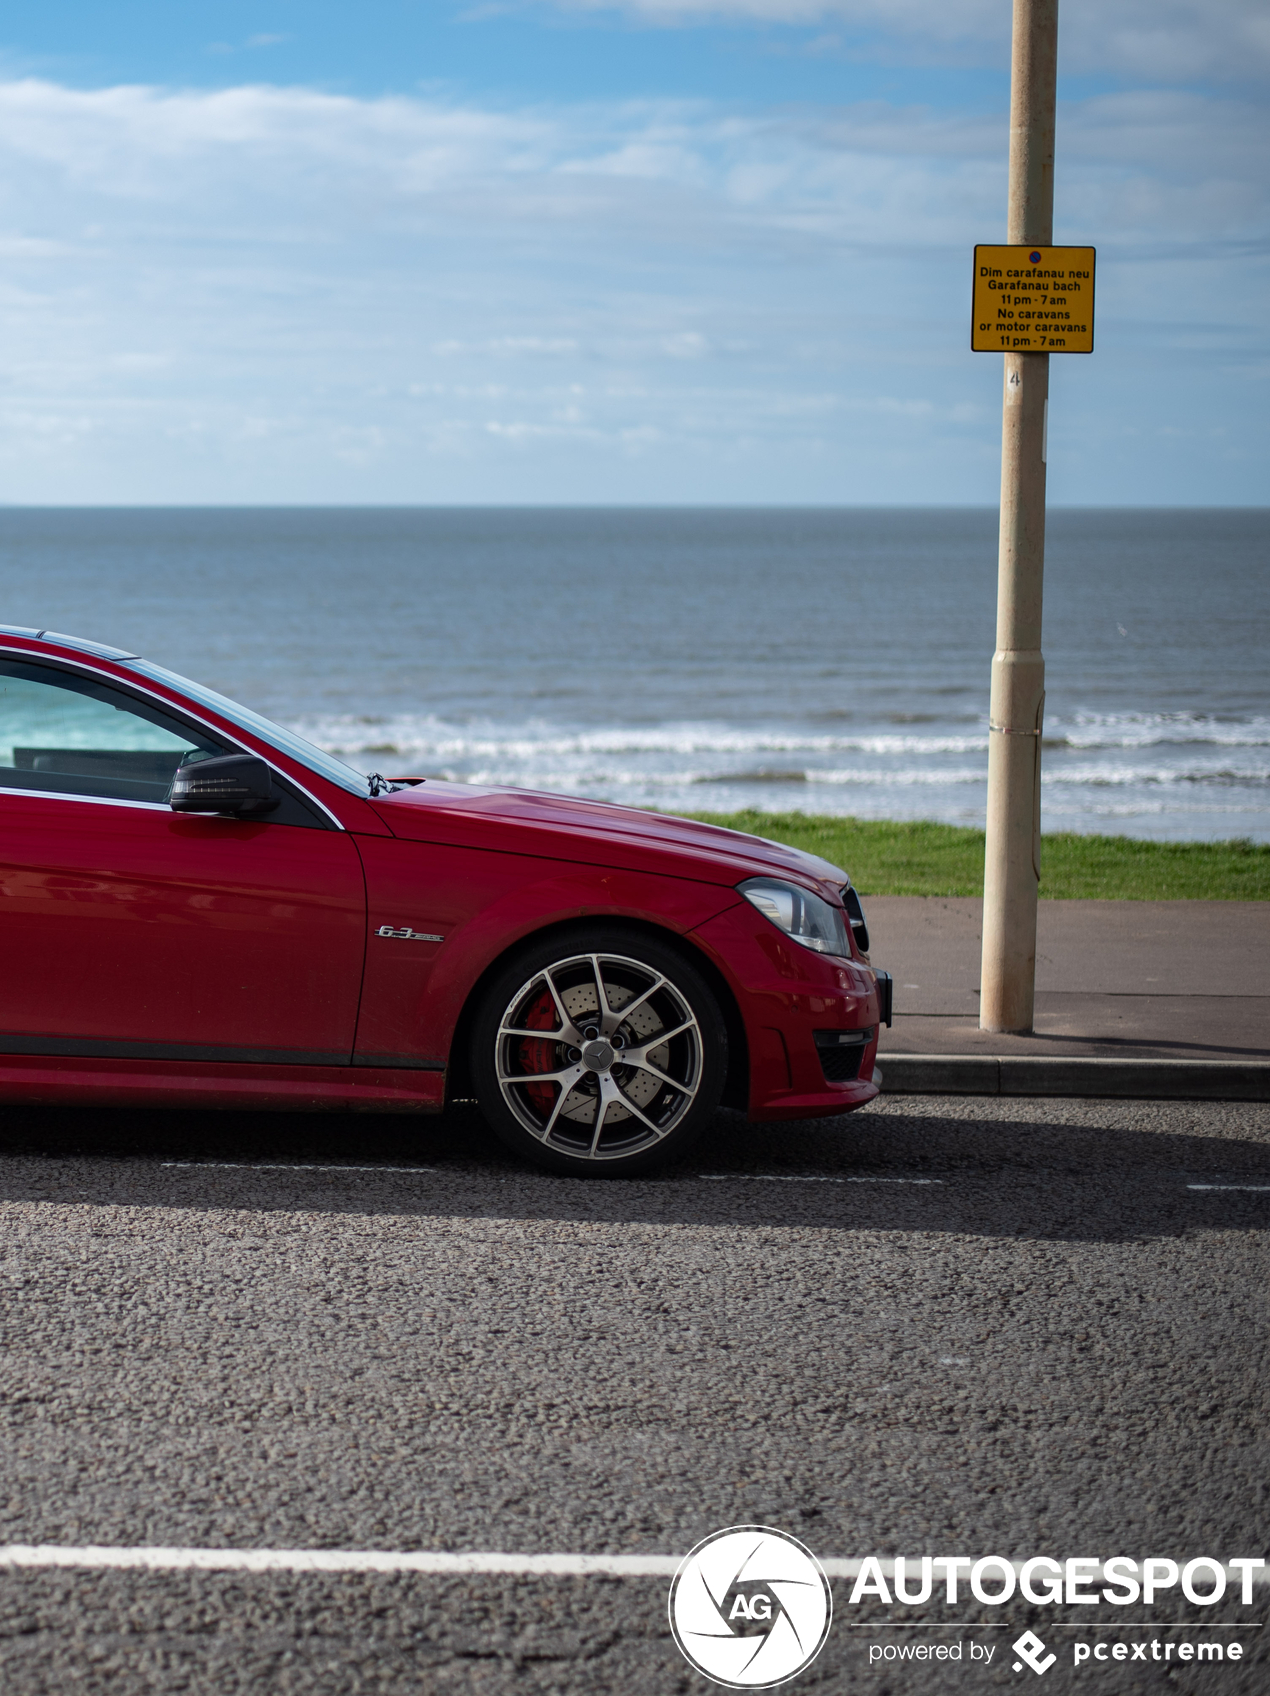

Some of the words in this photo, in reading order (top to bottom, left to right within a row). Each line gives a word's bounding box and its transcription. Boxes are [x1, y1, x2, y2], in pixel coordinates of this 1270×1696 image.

[980, 267, 1002, 277] Dim
[1006, 268, 1064, 278] carafanau
[1068, 270, 1089, 279] neu
[988, 280, 1049, 291] Garafanau
[1053, 281, 1081, 291] bach
[1001, 295, 1011, 304] 11
[1014, 297, 1031, 306] pm
[1040, 295, 1047, 305] 7
[1050, 297, 1067, 305] am
[997, 309, 1014, 319] No
[1018, 311, 1070, 319] caravans
[979, 323, 991, 331] or
[996, 322, 1031, 331] motor
[1034, 324, 1087, 332] caravans
[1000, 336, 1010, 345] 11
[1013, 338, 1030, 347] pm
[1039, 336, 1046, 346] 7
[1048, 338, 1066, 346] am
[1010, 371, 1020, 386] 4
